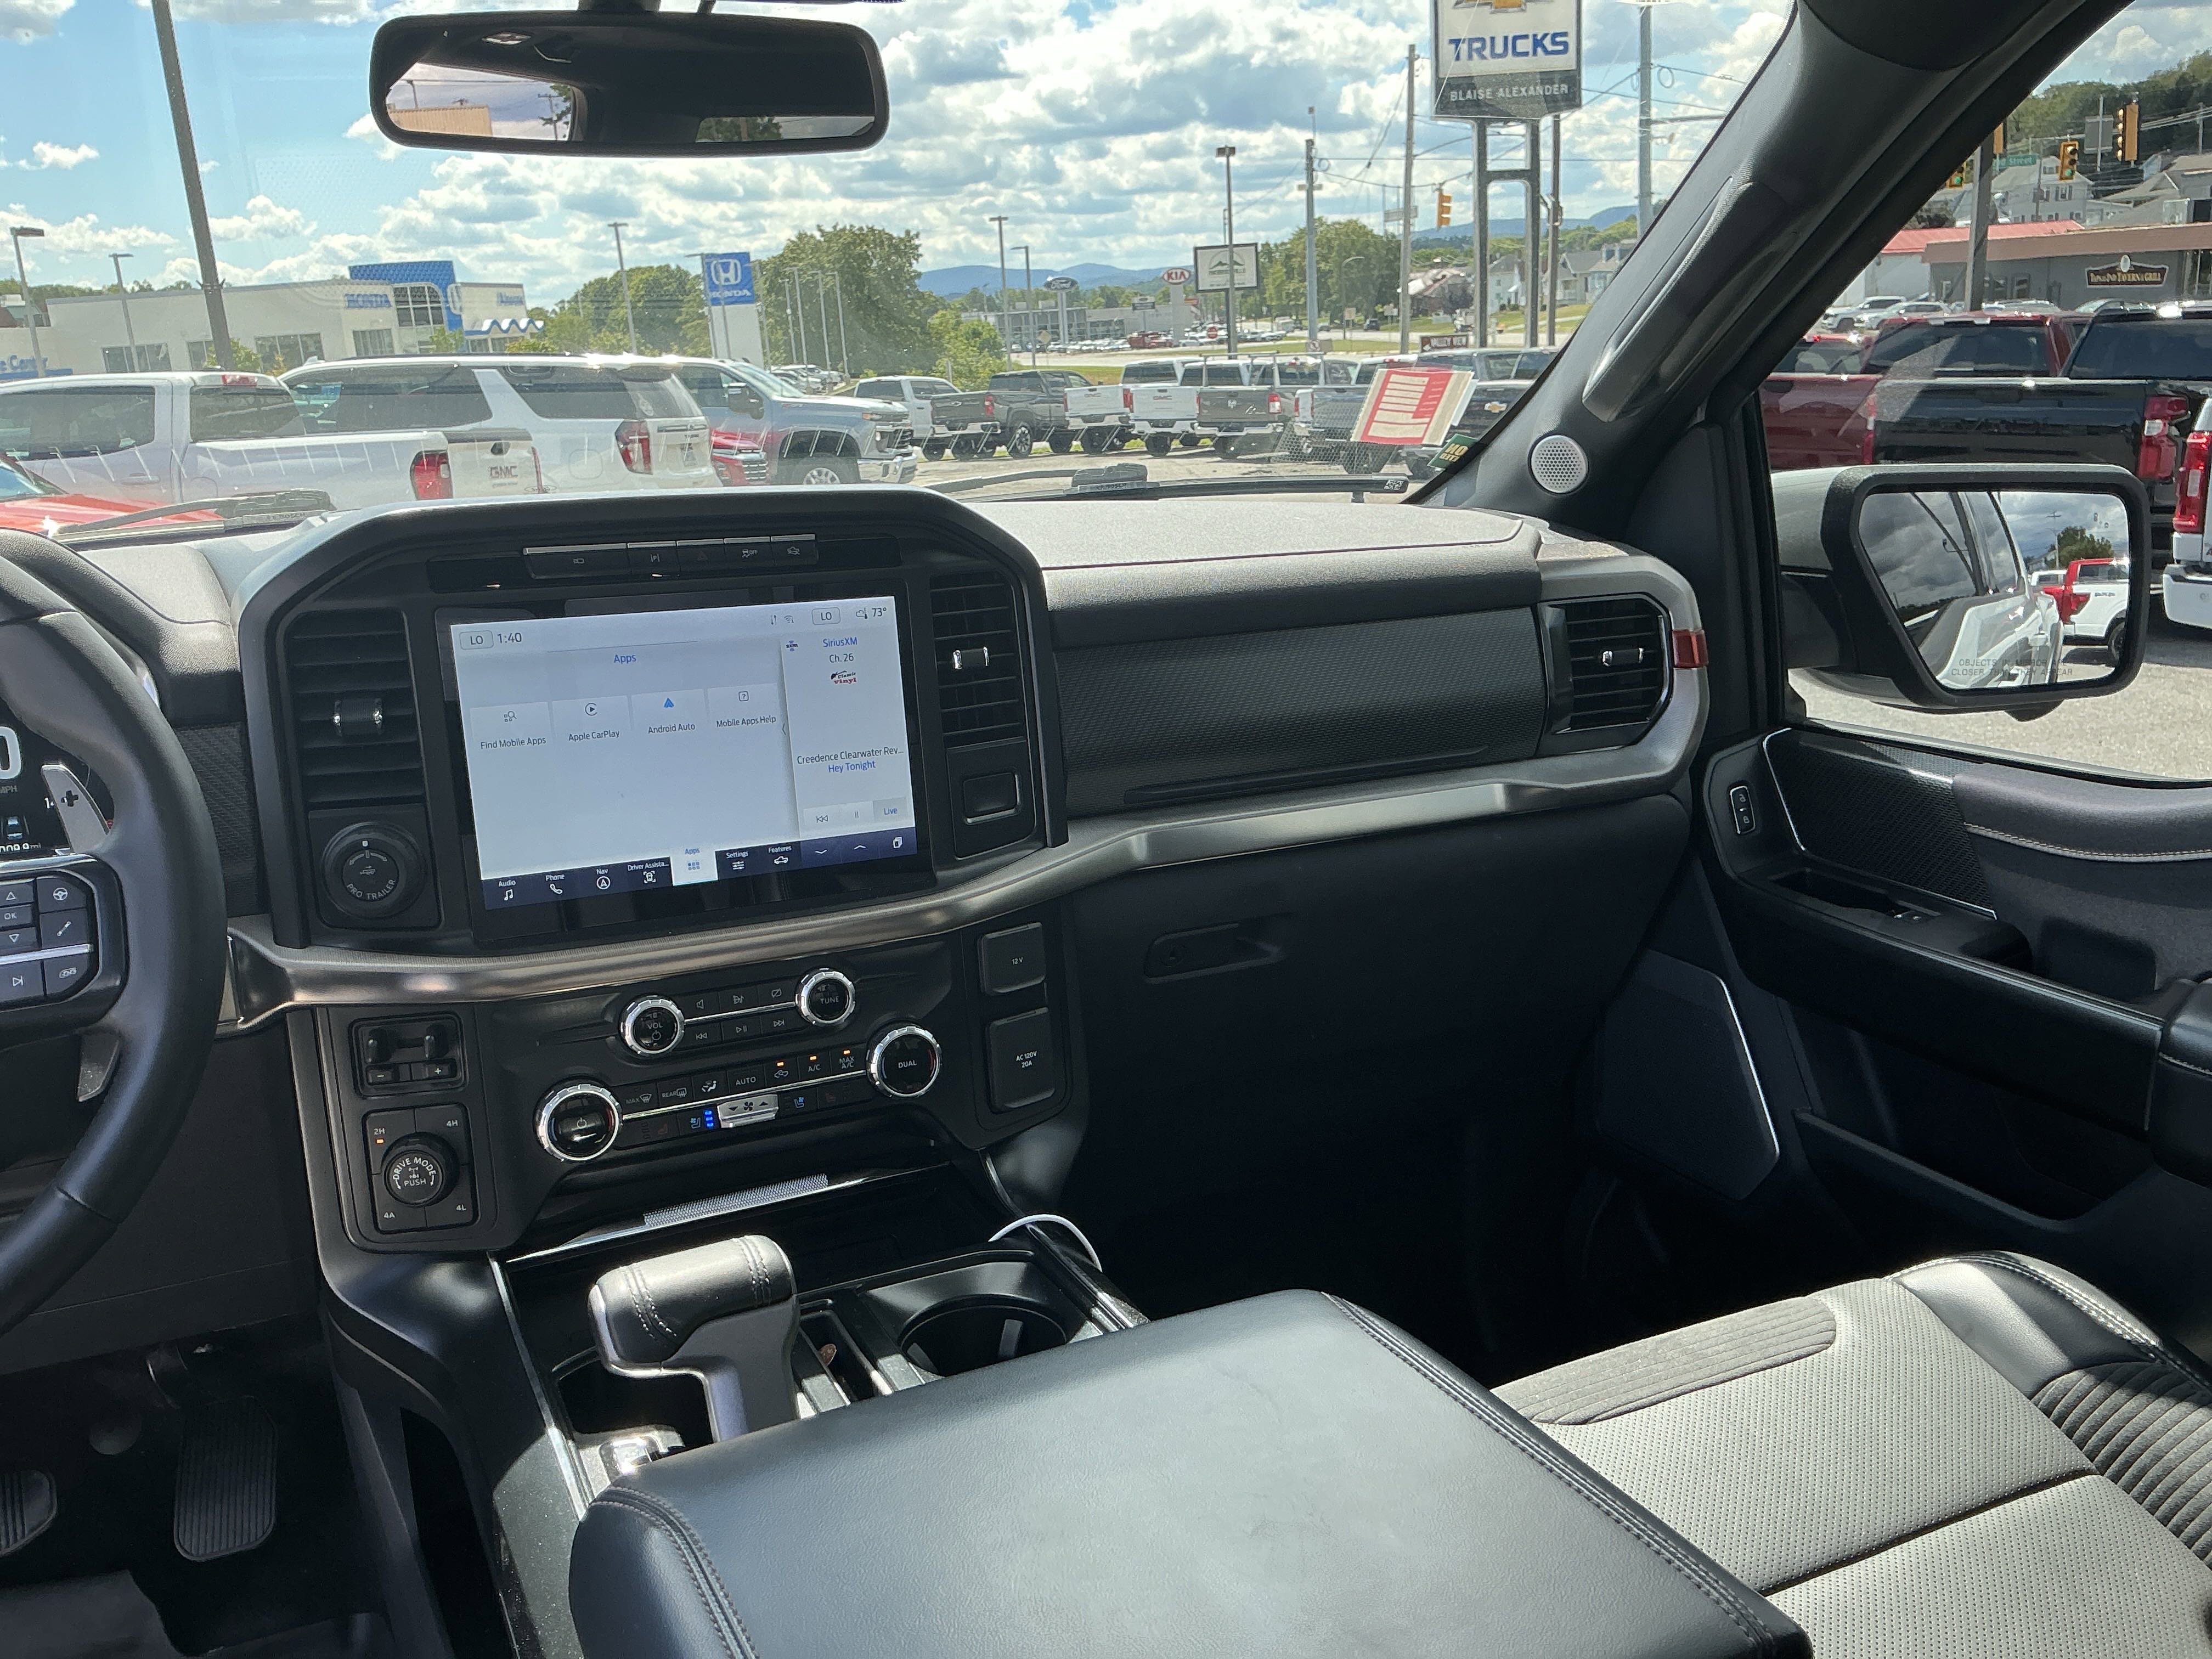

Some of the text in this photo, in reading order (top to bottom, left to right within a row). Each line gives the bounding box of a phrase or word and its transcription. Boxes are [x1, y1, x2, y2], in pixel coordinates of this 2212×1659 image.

[1448, 31, 1569, 61] TRUCKS
[1450, 83, 1568, 101] BLAISE ALEXANDER
[1166, 271, 1188, 281] KIA
[1050, 279, 1072, 290] Ford
[489, 465, 518, 479] GMC
[821, 607, 887, 620] LO 73°
[470, 632, 522, 646] LO 1:40
[823, 636, 857, 647] SiriusXM
[613, 653, 637, 664] Apps
[829, 653, 854, 663] Ch. 26
[1951, 668, 1984, 676] CLOSER
[716, 715, 776, 728] Mobile Apps Help
[648, 723, 696, 734] Android Auto
[568, 729, 620, 742] Apple CarPlay
[481, 736, 546, 750] Find Mobile Apps
[797, 753, 839, 764] Creedence
[840, 747, 883, 760] Clearwater
[828, 760, 876, 774] Hey Tonight
[726, 851, 749, 859] Settings
[627, 863, 644, 871] Driver
[545, 873, 565, 882] Phone
[346, 879, 396, 900] PRO TRAILER
[820, 996, 840, 1005] TUNE
[1015, 1051, 1037, 1062] AC 120V
[808, 1064, 821, 1072] A/C
[841, 1061, 854, 1069] A/C
[898, 1060, 917, 1069] DUAL
[1022, 1060, 1032, 1068] 20A
[735, 1076, 757, 1086] AUTO
[446, 1119, 458, 1127] 4H
[392, 1156, 437, 1181] DRIVE MODE
[404, 1178, 426, 1187] PUSH
